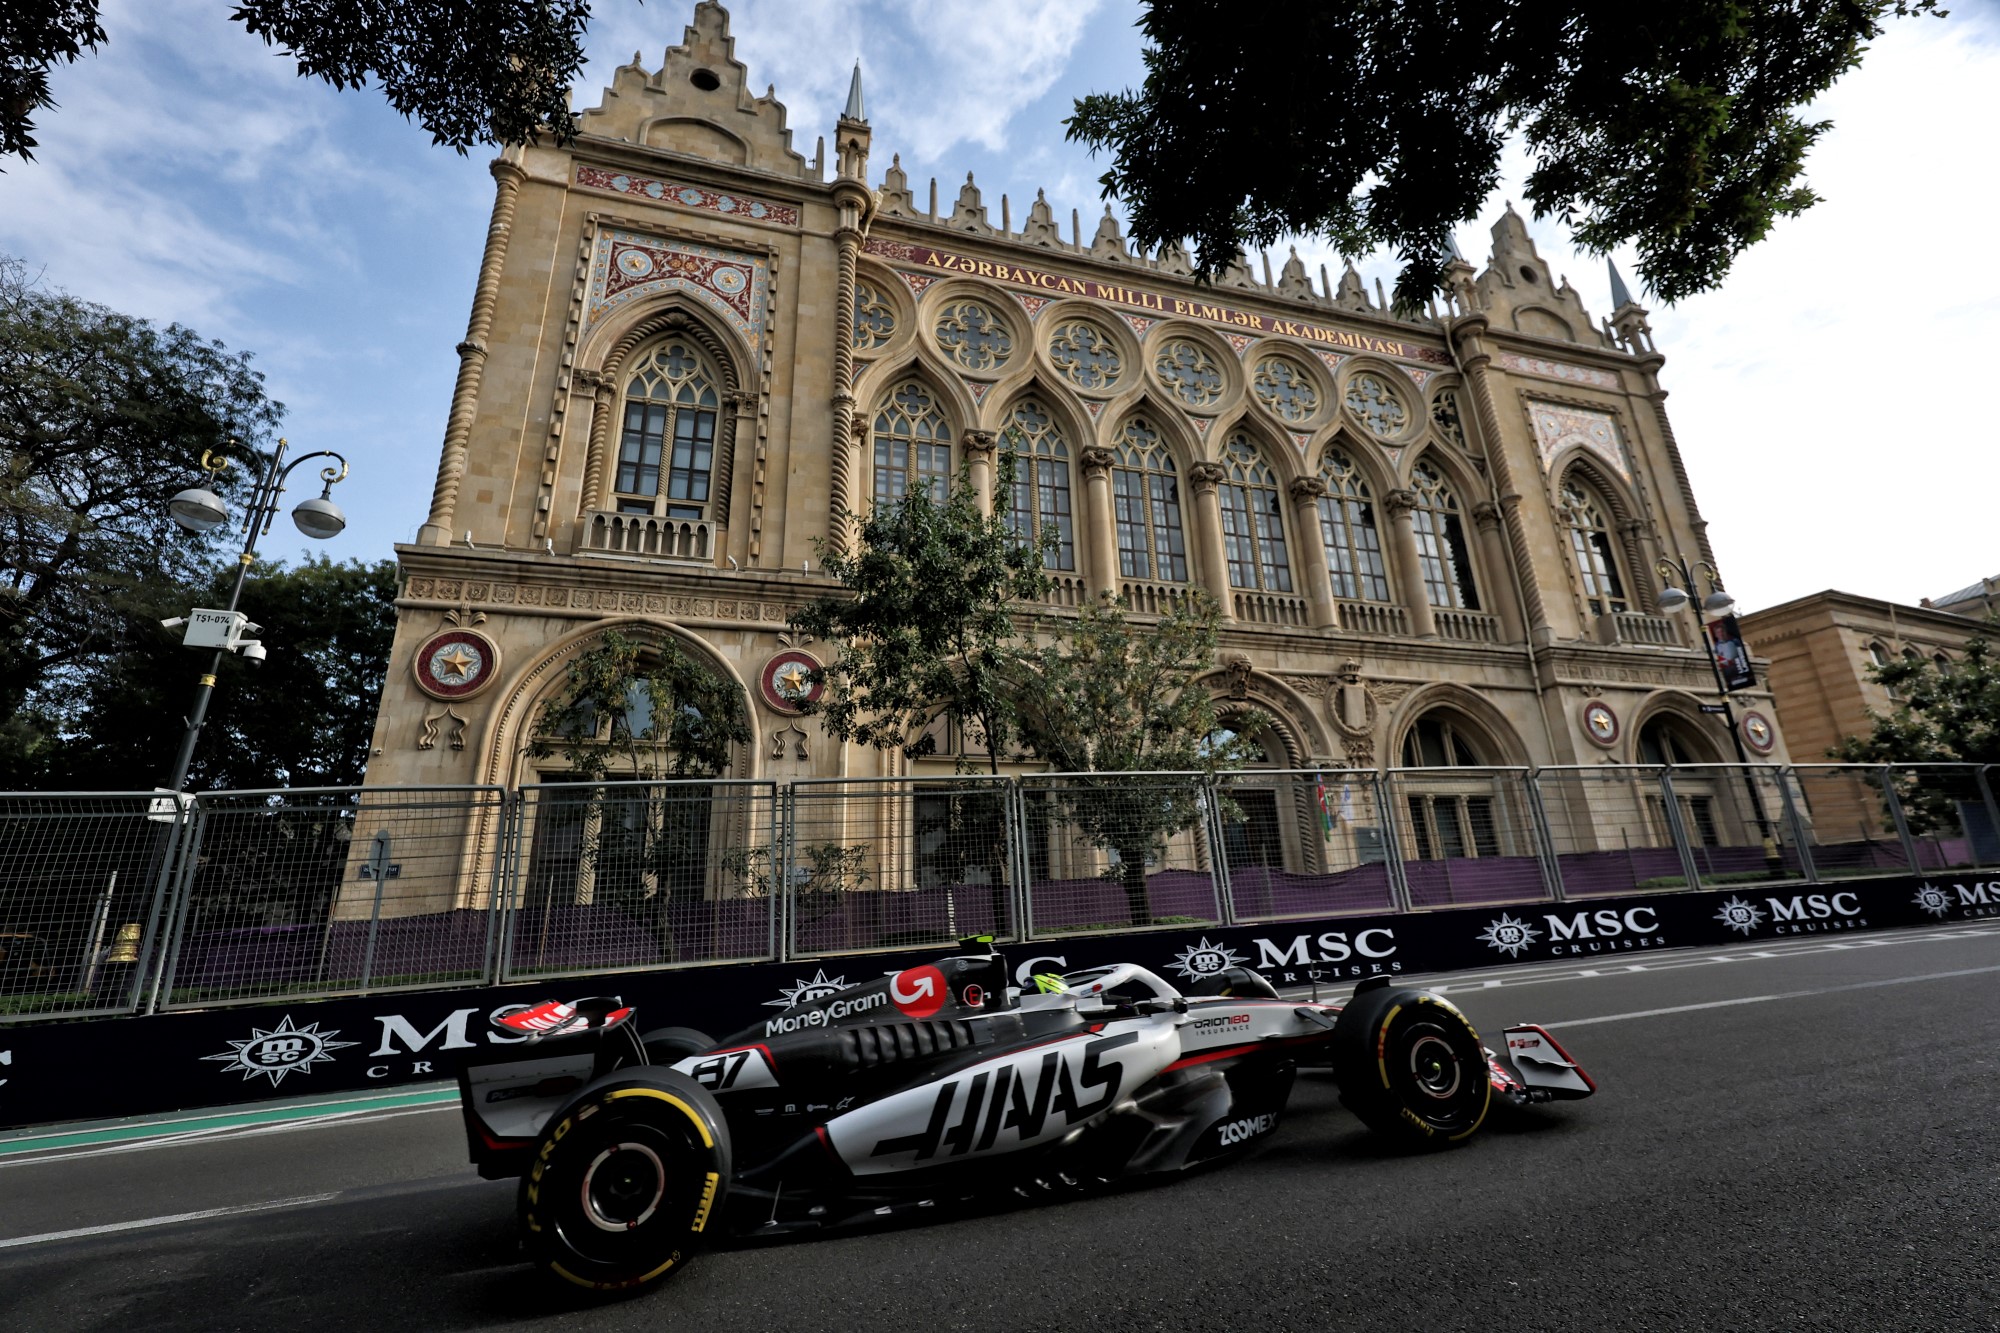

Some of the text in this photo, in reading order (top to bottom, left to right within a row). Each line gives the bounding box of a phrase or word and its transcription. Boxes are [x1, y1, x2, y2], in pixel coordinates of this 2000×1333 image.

[925, 251, 1404, 356] AZƏRBAYCAN MİLLİ ELMLƏR AKADEMİYASI
[1543, 907, 1660, 942] MSC
[1765, 892, 1862, 922] MSC
[1776, 918, 1868, 934] CRUISES
[1252, 928, 1398, 969] MSC
[1552, 936, 1666, 955] CRUISES
[765, 991, 887, 1038] MoneyGram
[1196, 1024, 1250, 1036] INSURANCE
[692, 1051, 750, 1091] 87
[870, 1031, 1139, 1161] HAAS
[1218, 1112, 1277, 1146] ZOOMEX
